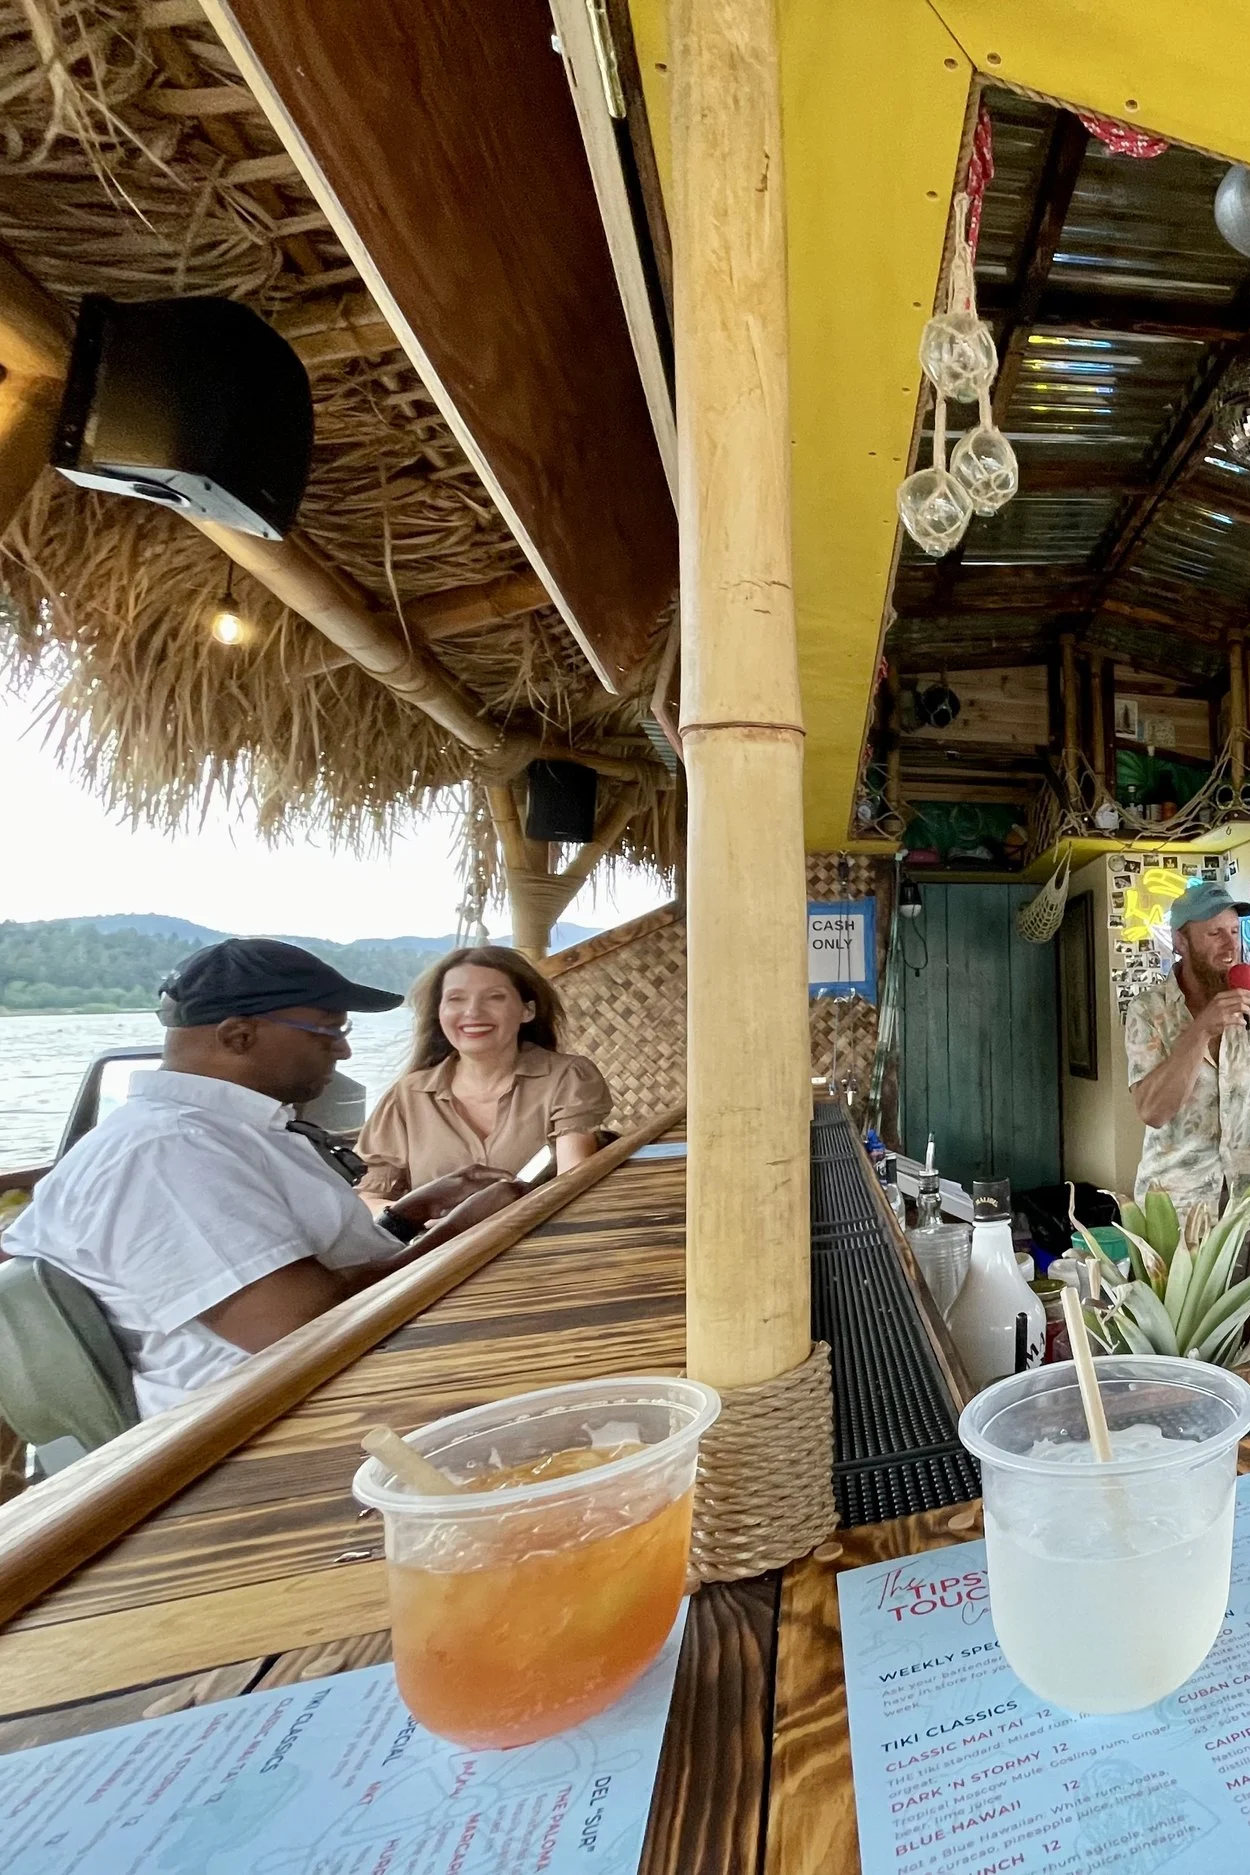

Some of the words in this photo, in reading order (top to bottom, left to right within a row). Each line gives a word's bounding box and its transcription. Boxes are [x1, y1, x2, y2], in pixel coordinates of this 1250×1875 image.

[812, 920, 855, 931] CASH
[812, 939, 852, 949] ONLY
[866, 1560, 926, 1610] The
[879, 1654, 954, 1682] WEEKLY
[882, 1685, 905, 1698] Ask
[909, 1675, 937, 1691] your
[941, 1656, 1003, 1678] bartender
[883, 1693, 915, 1707] have
[935, 1676, 967, 1690] store
[970, 1669, 988, 1679] for
[304, 1687, 332, 1711] TIKI
[1177, 1680, 1230, 1704] CUBAN
[1209, 1691, 1244, 1708] coffee
[260, 1713, 313, 1774] CLASSICS
[881, 1733, 919, 1753] TIKI
[926, 1700, 1018, 1738] CLASSICS
[885, 1741, 957, 1773] CLASSIC
[962, 1729, 993, 1746] MAI
[998, 1718, 1023, 1733] TAI
[1036, 1709, 1052, 1719] 12
[1008, 1726, 1044, 1745] Mixed
[1048, 1717, 1078, 1730] rum,
[590, 1776, 612, 1807] DEL
[891, 1786, 943, 1813] DARK
[948, 1778, 965, 1791] 'N
[971, 1750, 1040, 1783] STORMY
[1052, 1743, 1069, 1754] 12
[893, 1800, 949, 1828] Tropical
[954, 1779, 1007, 1806] Moscow
[1050, 1747, 1097, 1769] Gosling
[1101, 1738, 1129, 1751] rum,
[1132, 1724, 1171, 1742] Ginger
[552, 1784, 573, 1812] THE
[895, 1829, 946, 1857] BLUE
[952, 1800, 1022, 1834] HAWAII
[1062, 1779, 1081, 1792] 12
[935, 1808, 965, 1826] lime
[969, 1794, 1003, 1815] juice
[1004, 1816, 1073, 1850] pineapple
[1077, 1801, 1113, 1822] juice,
[1115, 1789, 1144, 1804] lime
[1148, 1777, 1178, 1796] juice
[898, 1860, 924, 1875] Not
[941, 1841, 975, 1859] Blue
[1050, 1794, 1092, 1815] White
[1128, 1769, 1170, 1787] vodka,
[536, 1813, 564, 1872] PALOMA
[1042, 1854, 1081, 1875] rhum
[1148, 1813, 1186, 1833] white
[1042, 1840, 1061, 1854] 12
